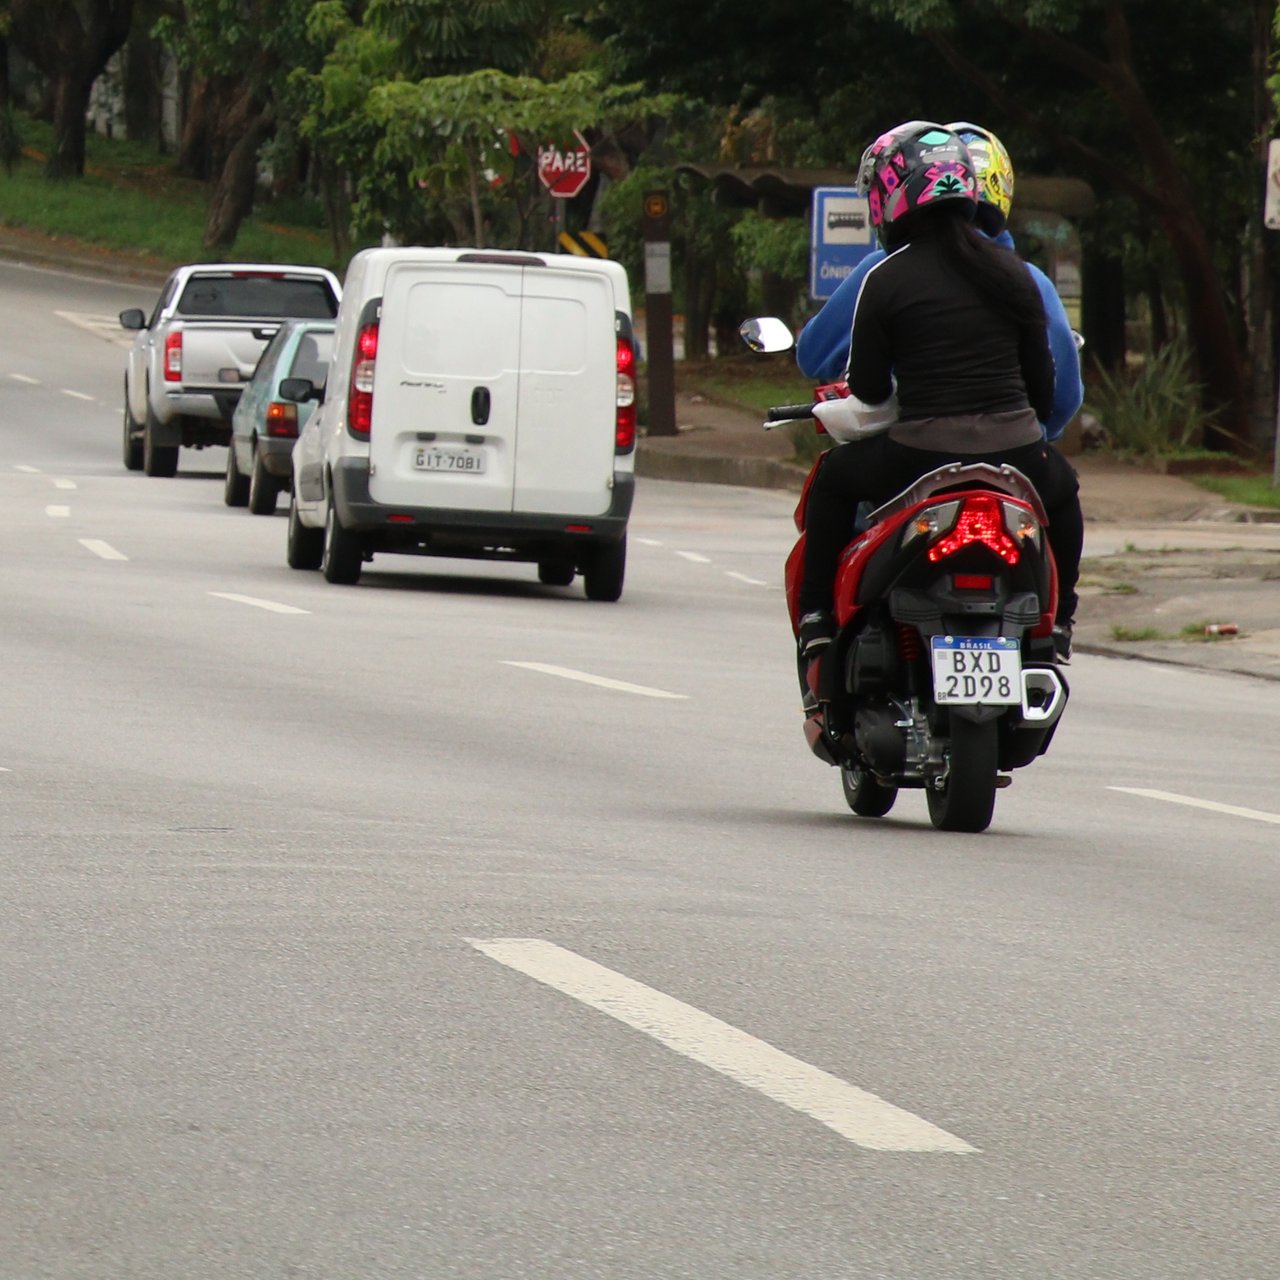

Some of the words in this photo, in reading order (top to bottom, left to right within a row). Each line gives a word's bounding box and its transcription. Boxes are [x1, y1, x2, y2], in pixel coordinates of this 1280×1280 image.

[541, 150, 586, 172] PARE
[953, 651, 1001, 673] BXD
[946, 676, 1011, 698] 2D98
